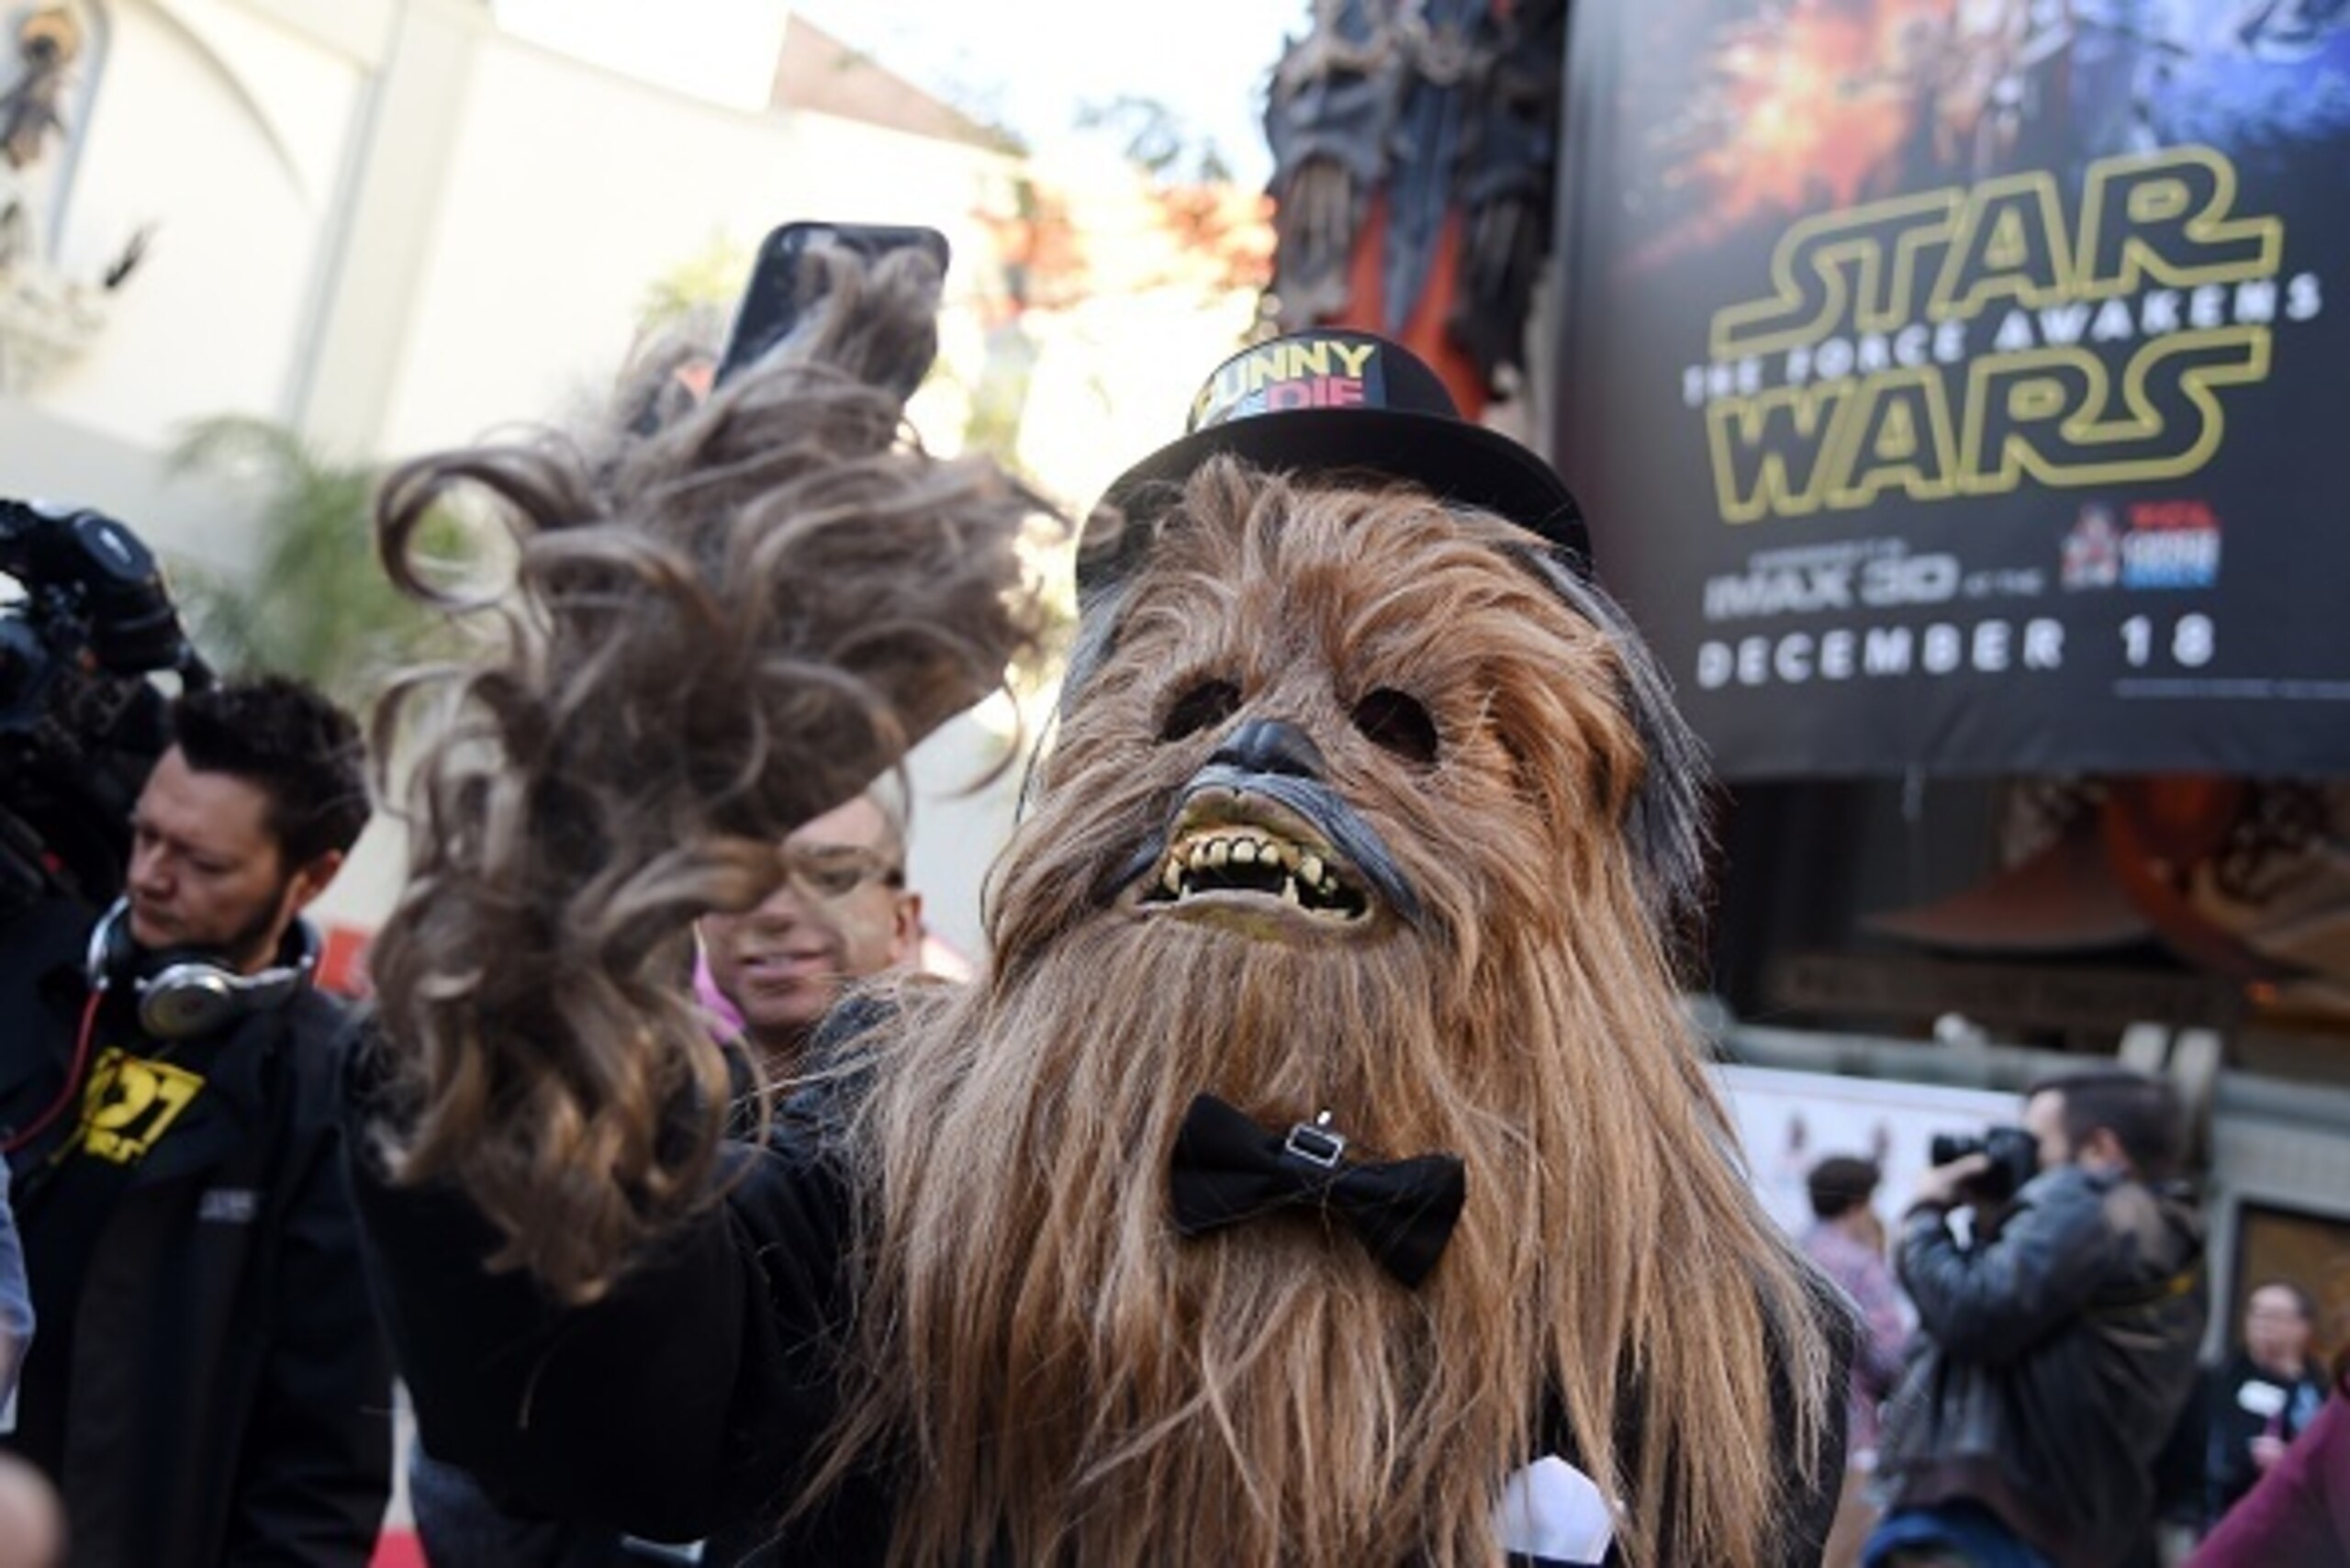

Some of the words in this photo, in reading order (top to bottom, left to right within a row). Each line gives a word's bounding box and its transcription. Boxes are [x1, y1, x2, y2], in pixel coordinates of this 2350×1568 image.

[1708, 147, 2285, 360] STAR
[1683, 354, 1763, 407] THE
[1785, 319, 1967, 384] FORCE
[1991, 273, 2322, 353] AWAKENS
[1706, 324, 2272, 524] WARS
[1696, 617, 2065, 689] DECEMBER
[2120, 612, 2215, 667] 18
[1703, 562, 1854, 621] IMAX
[1860, 553, 1961, 607] 3D
